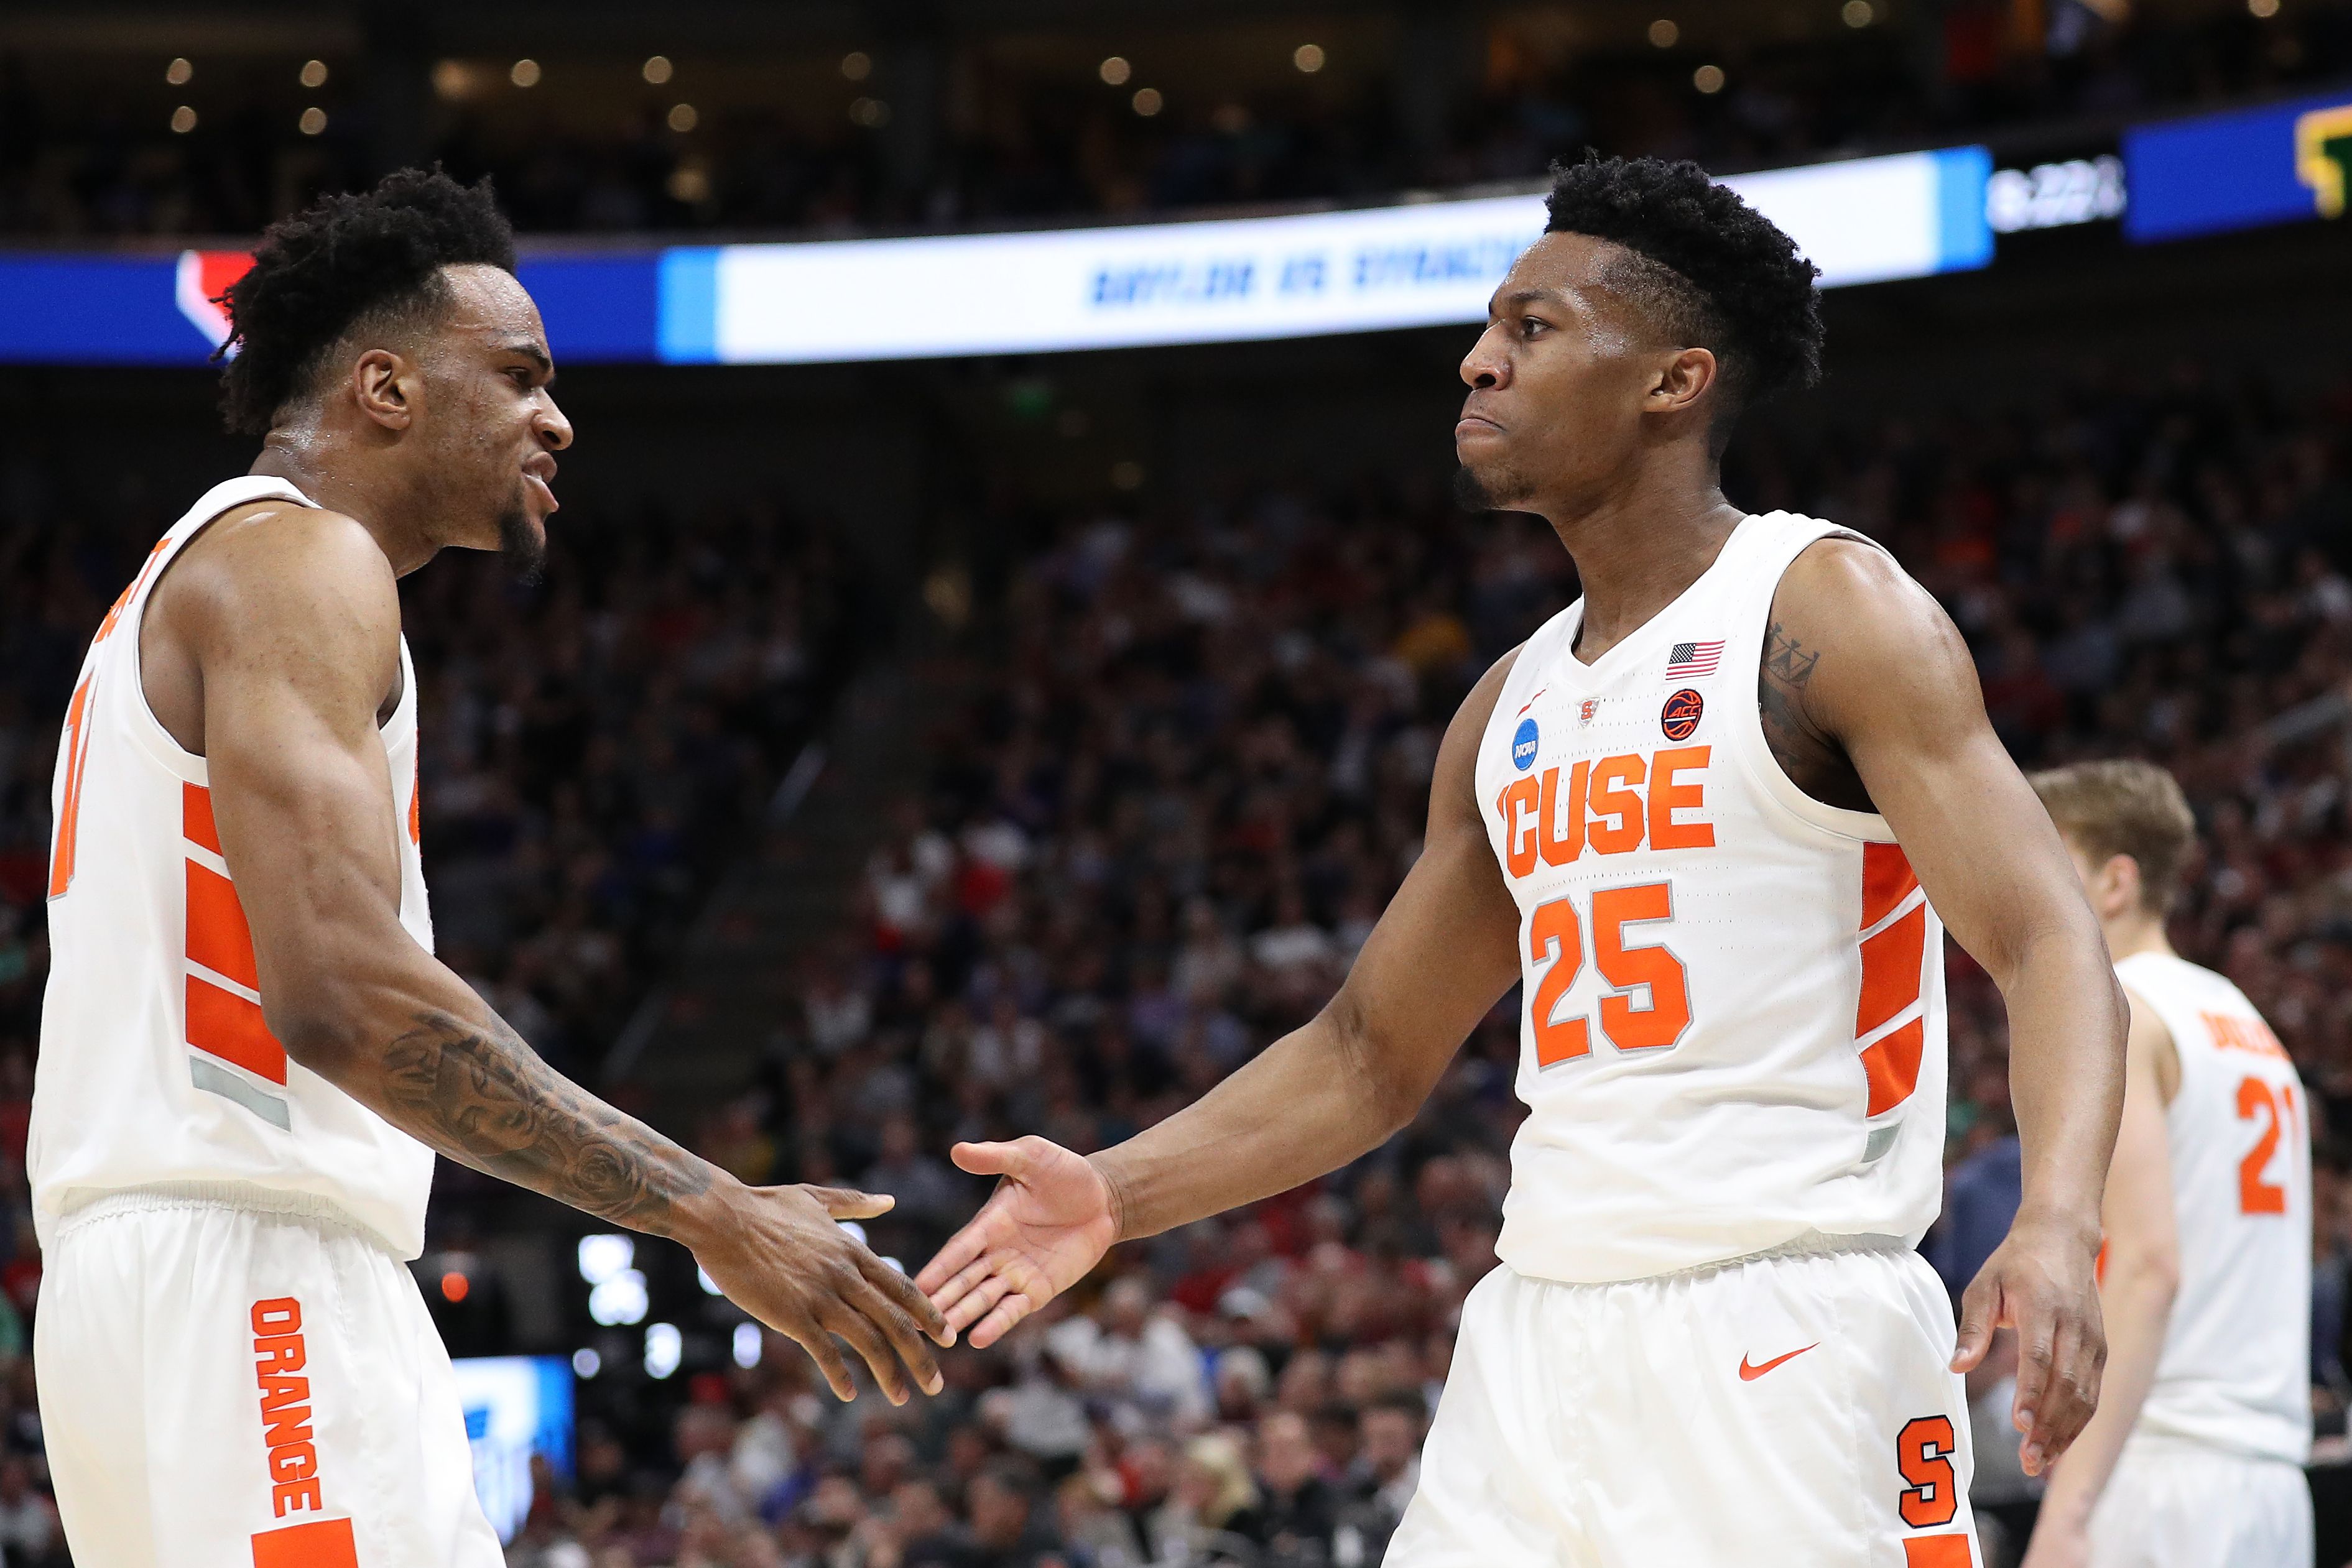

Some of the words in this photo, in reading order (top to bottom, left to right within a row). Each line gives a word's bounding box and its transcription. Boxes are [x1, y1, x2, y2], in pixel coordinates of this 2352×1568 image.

[1515, 740, 1536, 759] NCAA
[1668, 704, 1701, 718] ACC
[1529, 879, 1694, 1073] 25
[251, 1296, 322, 1518] ORANGE
[1897, 1414, 1958, 1529] S
